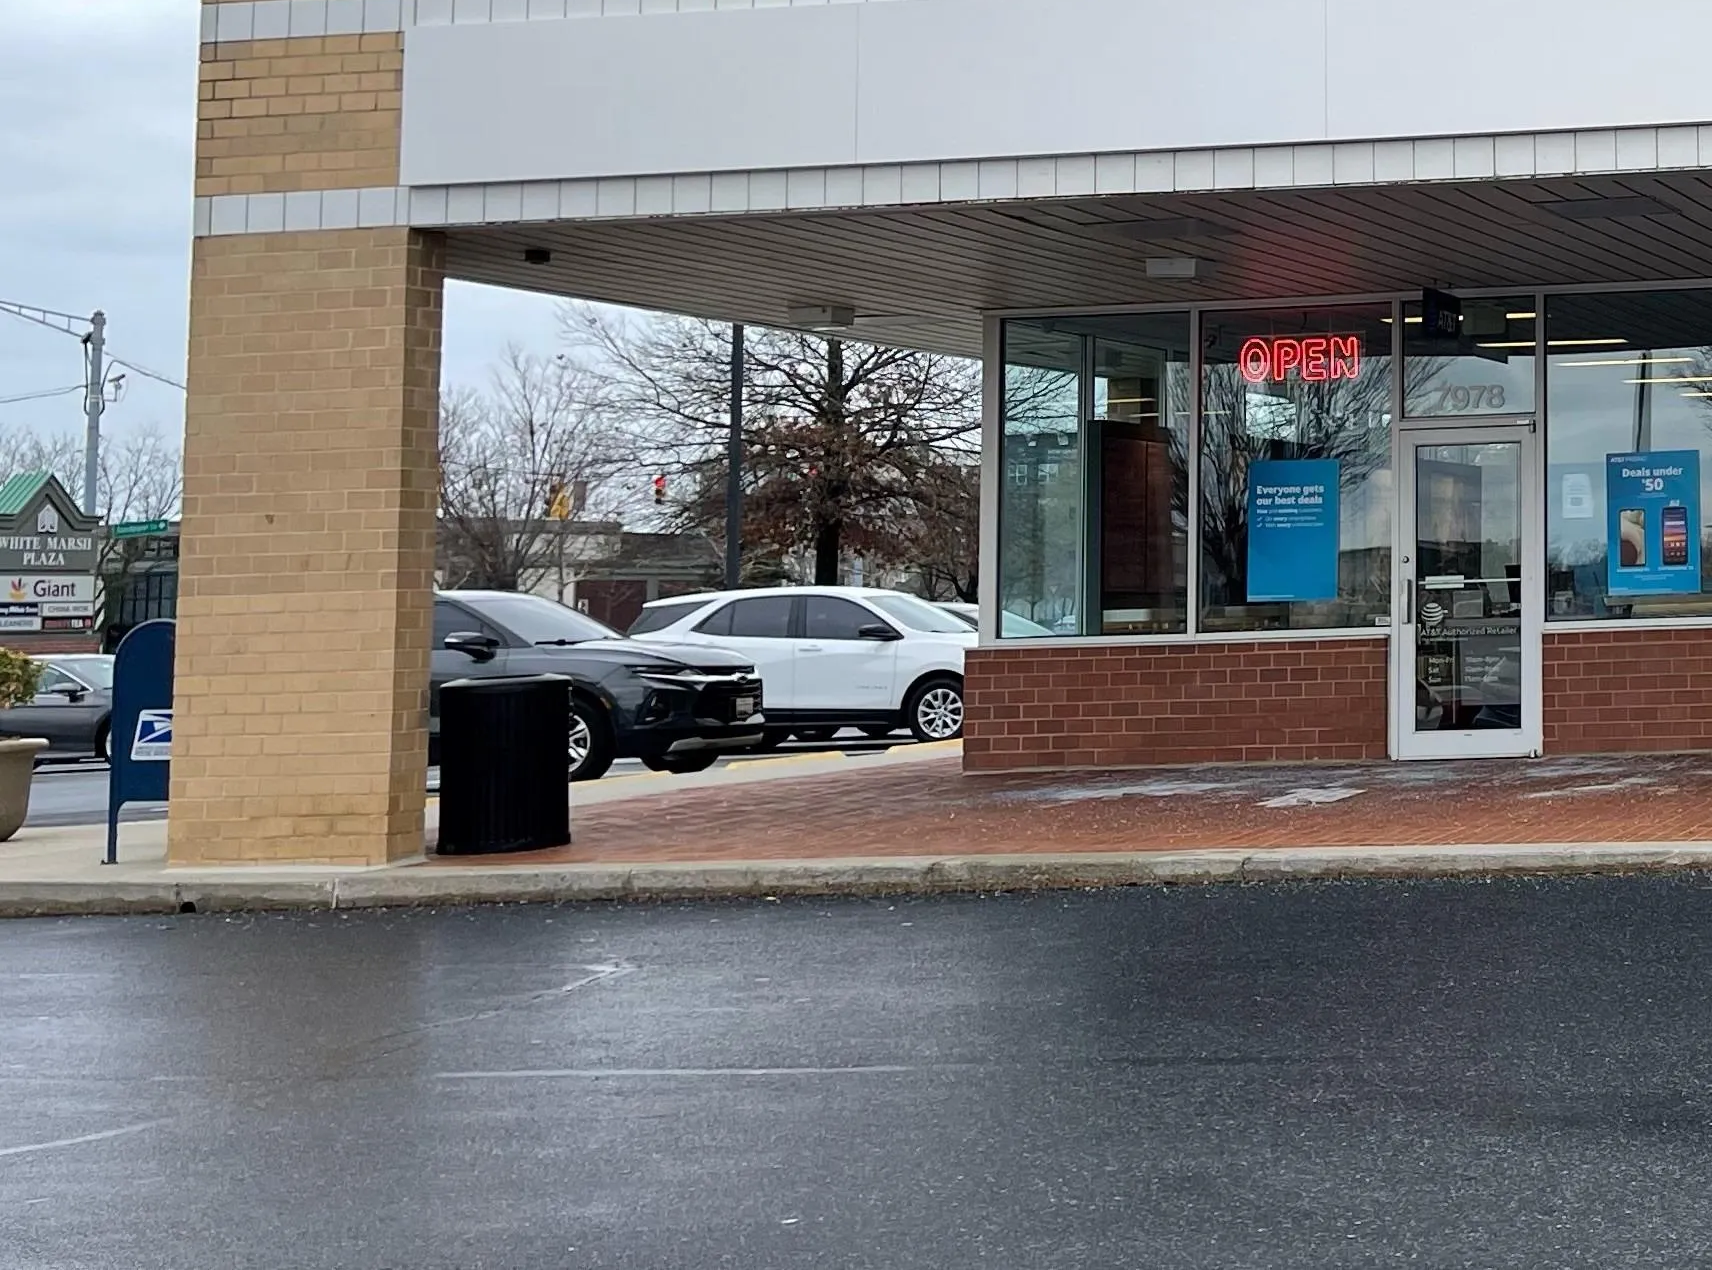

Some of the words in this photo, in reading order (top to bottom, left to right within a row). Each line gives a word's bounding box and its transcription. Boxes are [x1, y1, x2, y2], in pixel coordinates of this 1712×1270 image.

[1240, 336, 1359, 382] OPEN
[1435, 384, 1505, 411] 7978
[1622, 467, 1651, 478] Deals
[1653, 466, 1683, 476] under
[1257, 485, 1302, 496] Everyone
[1303, 485, 1325, 496] gets
[1256, 497, 1273, 506] our
[1274, 495, 1296, 505] best
[1297, 495, 1323, 504] deals
[0, 537, 40, 550] WHITE
[47, 536, 92, 550] MARSH
[23, 552, 65, 566] PLAZA
[34, 579, 76, 597] Giant
[1420, 628, 1440, 636] AT&T
[1442, 627, 1486, 636] Authorized
[1487, 626, 1517, 635] Retailer
